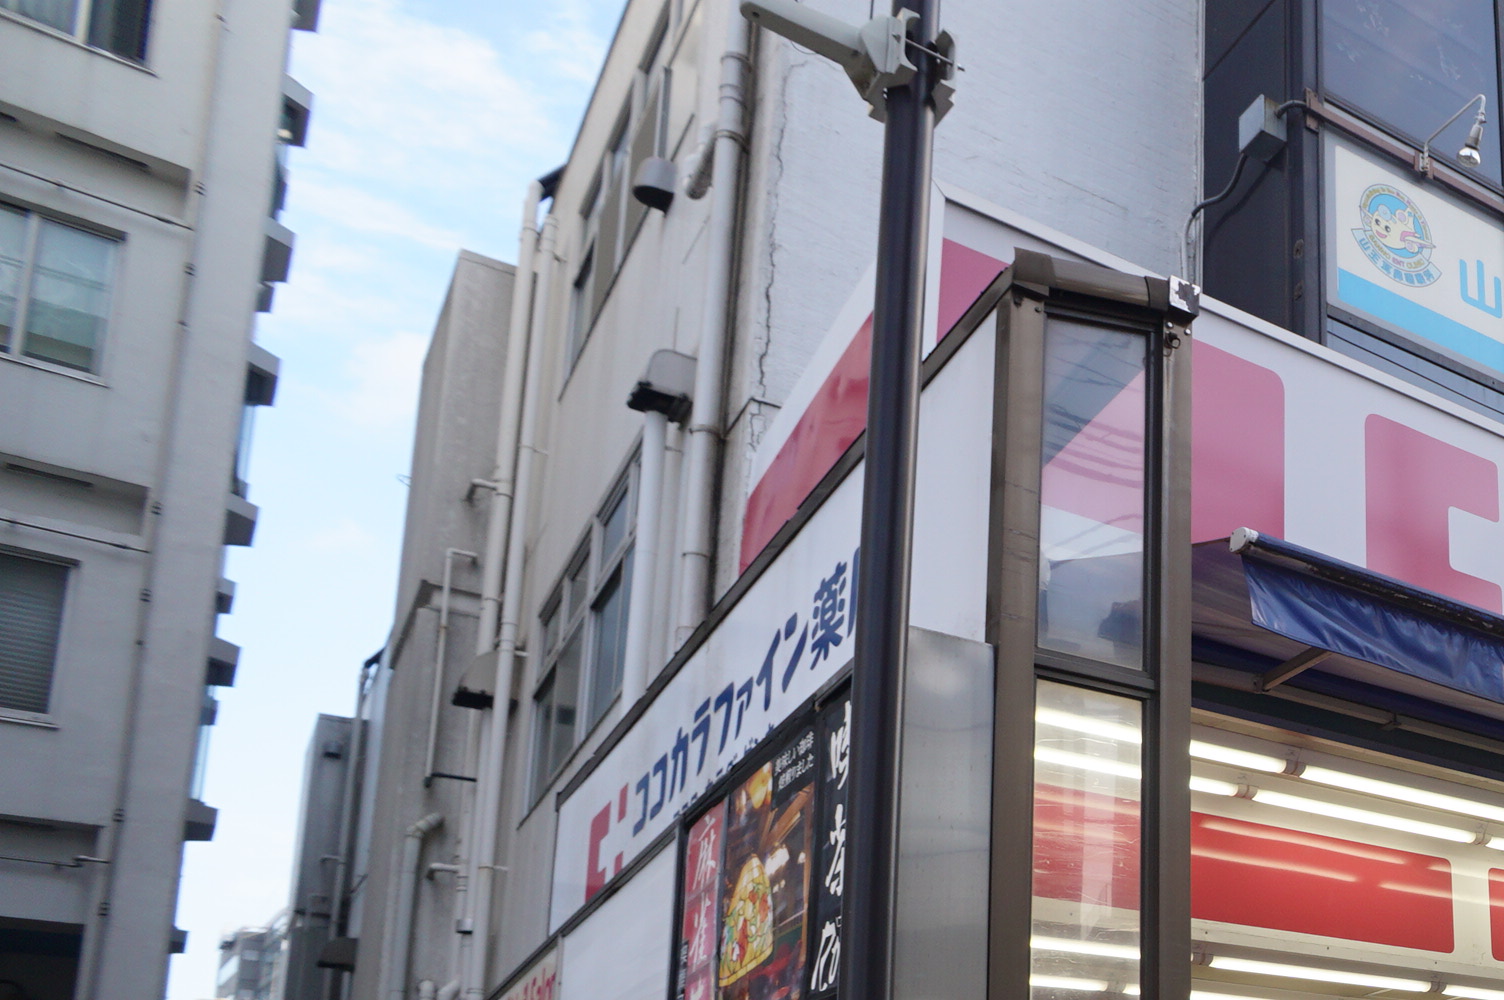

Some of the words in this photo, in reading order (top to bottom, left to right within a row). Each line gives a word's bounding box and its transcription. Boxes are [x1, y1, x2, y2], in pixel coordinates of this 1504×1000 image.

[632, 545, 860, 836] ココカラファイン薬
